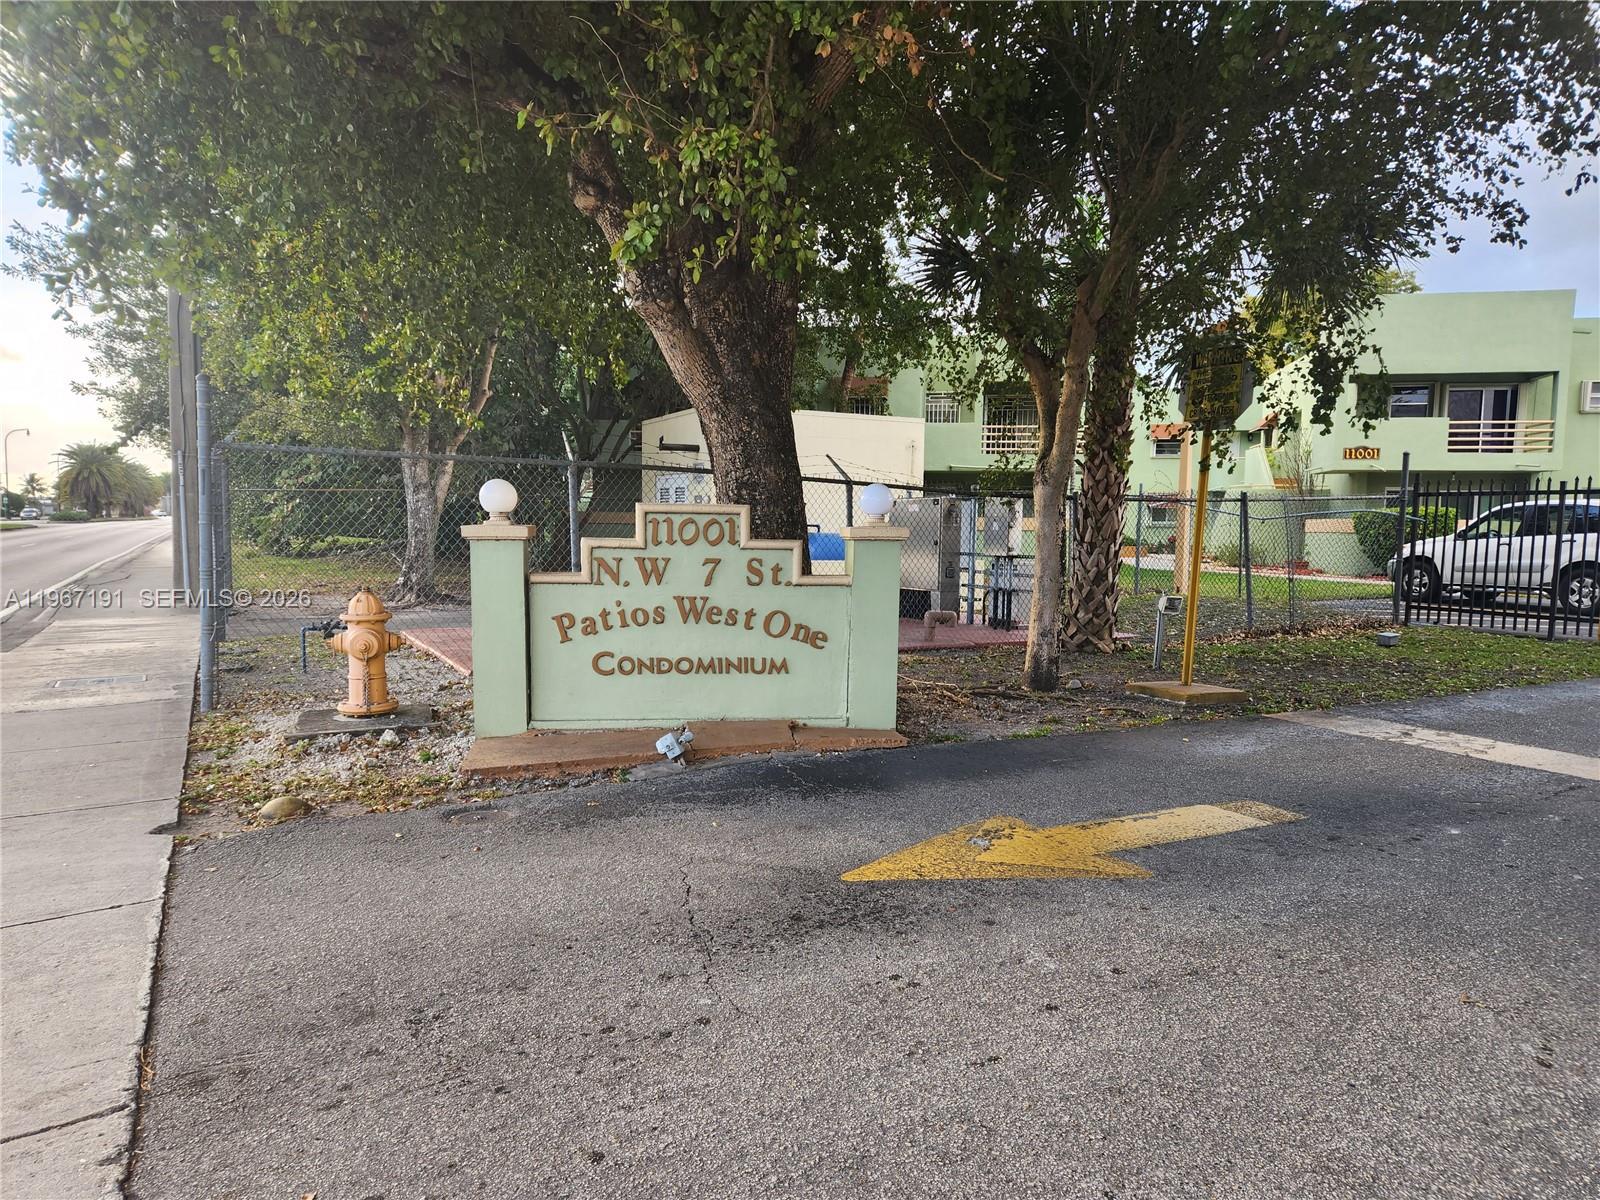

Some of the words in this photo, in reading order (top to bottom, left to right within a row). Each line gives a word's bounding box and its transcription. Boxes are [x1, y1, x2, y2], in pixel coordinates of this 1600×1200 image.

[1345, 449, 1378, 459] 11001
[649, 516, 739, 546] 11001
[702, 557, 721, 586] 7
[746, 557, 792, 587] St.
[552, 600, 665, 643] Patios
[673, 595, 756, 631] West
[762, 609, 828, 649] One
[591, 651, 789, 676] CONDOMINIUM
